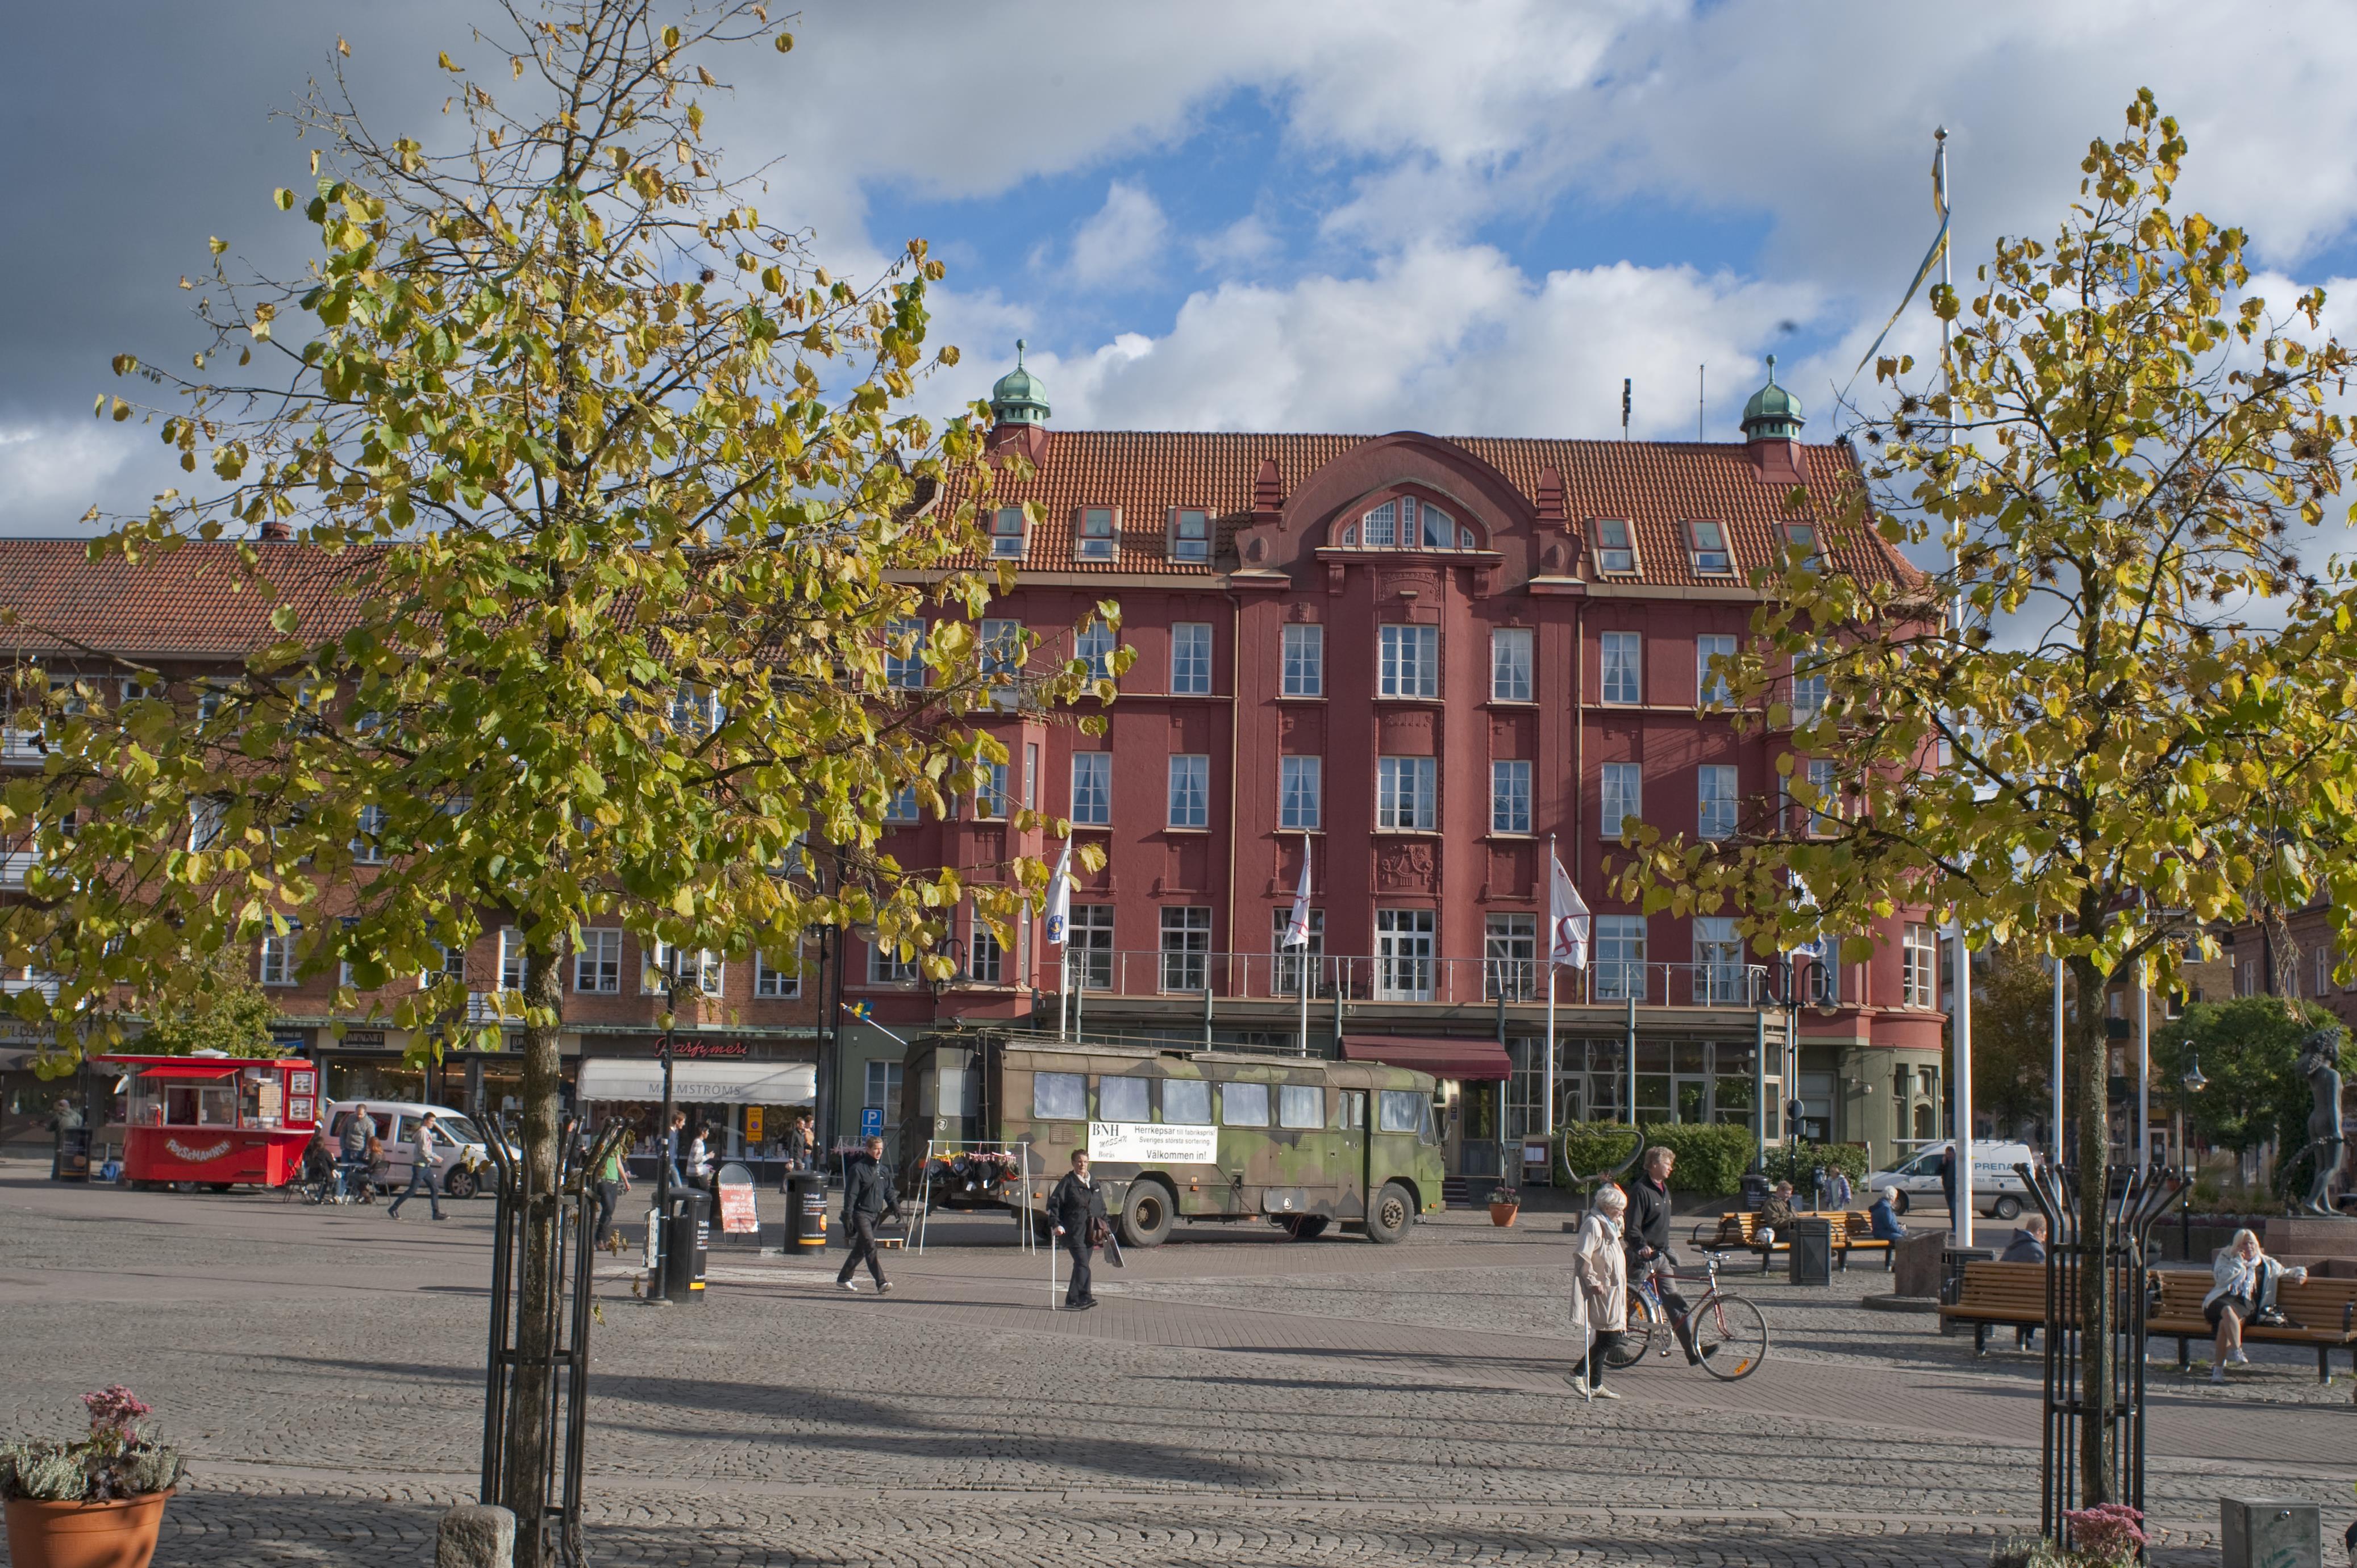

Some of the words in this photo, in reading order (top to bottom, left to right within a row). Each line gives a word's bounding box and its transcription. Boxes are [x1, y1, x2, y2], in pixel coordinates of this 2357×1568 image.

[649, 1083, 741, 1095] MMSTRÖMS
[868, 1111, 877, 1124] P
[1093, 1124, 1119, 1136] BNH
[1135, 1125, 1175, 1136] Herrkepsar
[1147, 1149, 1194, 1160] Välkommen
[1196, 1151, 1206, 1160] in!
